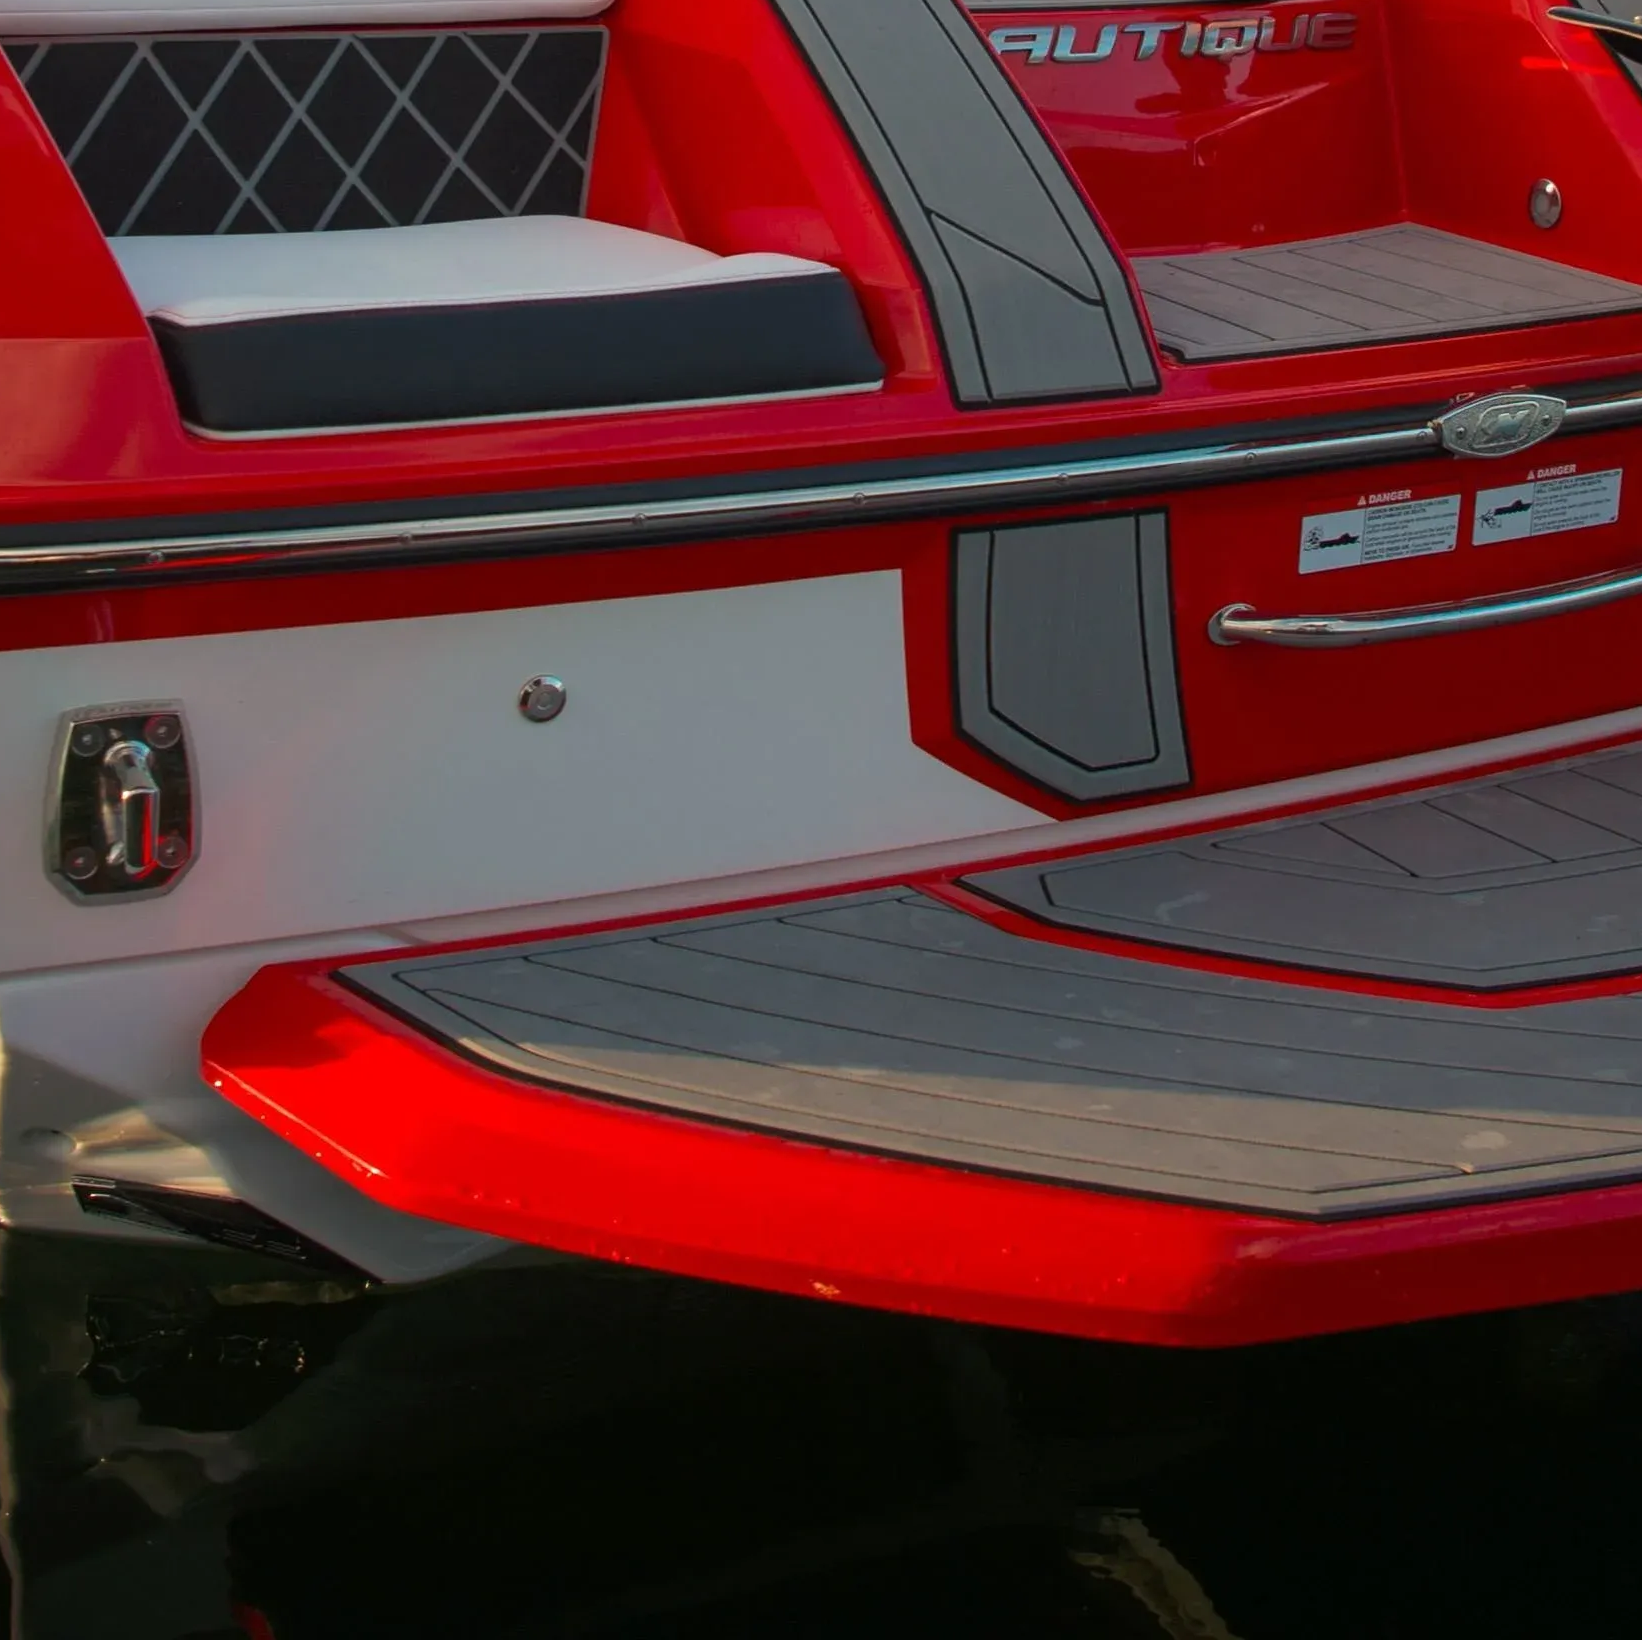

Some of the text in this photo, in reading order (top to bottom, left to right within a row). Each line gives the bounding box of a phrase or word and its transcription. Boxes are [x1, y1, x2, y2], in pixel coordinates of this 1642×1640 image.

[989, 12, 1358, 65] AUTIQUE
[1537, 463, 1577, 479] DANGER
[1369, 489, 1412, 505] DANGER
